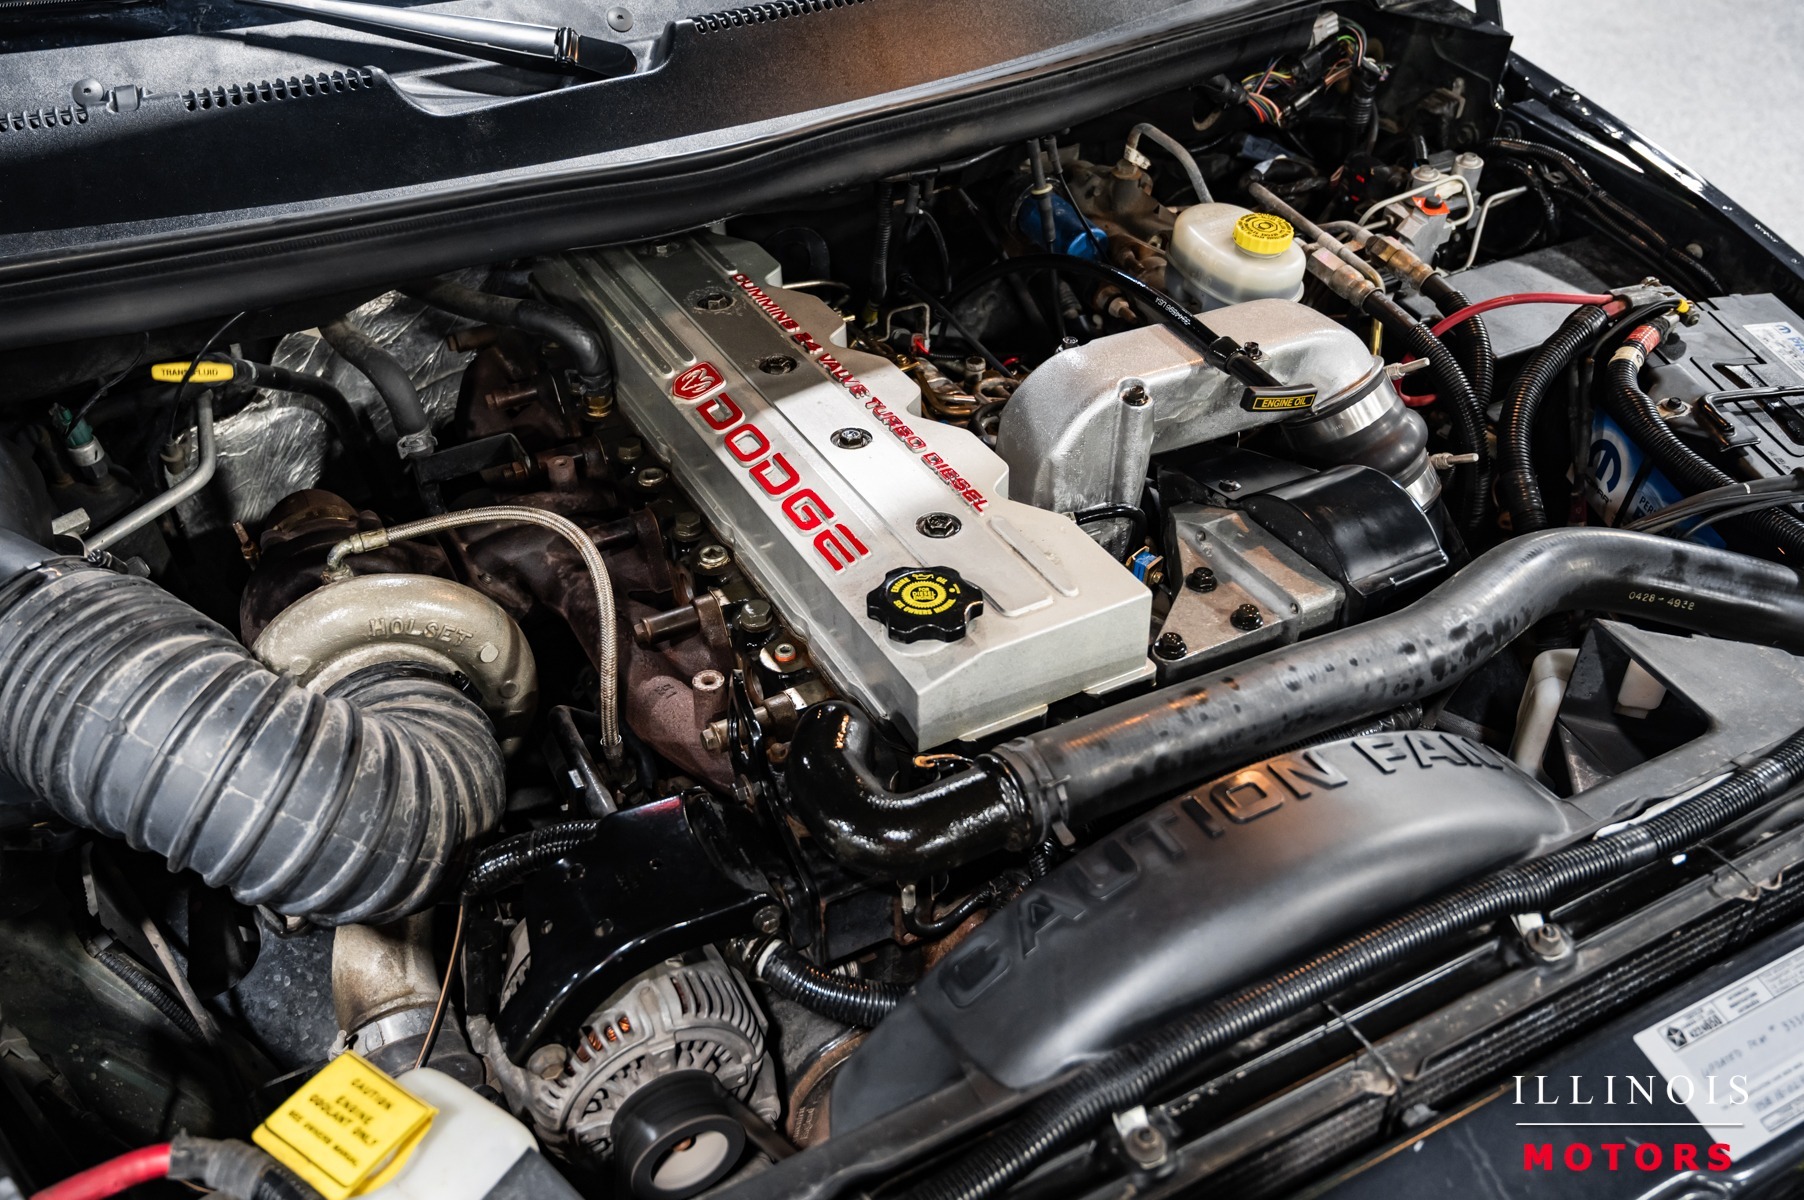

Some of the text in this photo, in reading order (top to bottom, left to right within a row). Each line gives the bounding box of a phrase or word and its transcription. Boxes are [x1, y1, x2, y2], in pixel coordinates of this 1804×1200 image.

[1261, 395, 1307, 408] ENGINE OIL
[817, 353, 870, 399] VALVE
[865, 397, 927, 453] TURBO
[921, 452, 989, 516] DIESEL
[695, 391, 871, 575] DODGE
[368, 617, 474, 646] HOLSET
[936, 750, 1348, 1009] CAUTION
[336, 1095, 374, 1125] ENGINE
[351, 1078, 393, 1111] CAUTION
[309, 1094, 378, 1149] COOLANT ONLY
